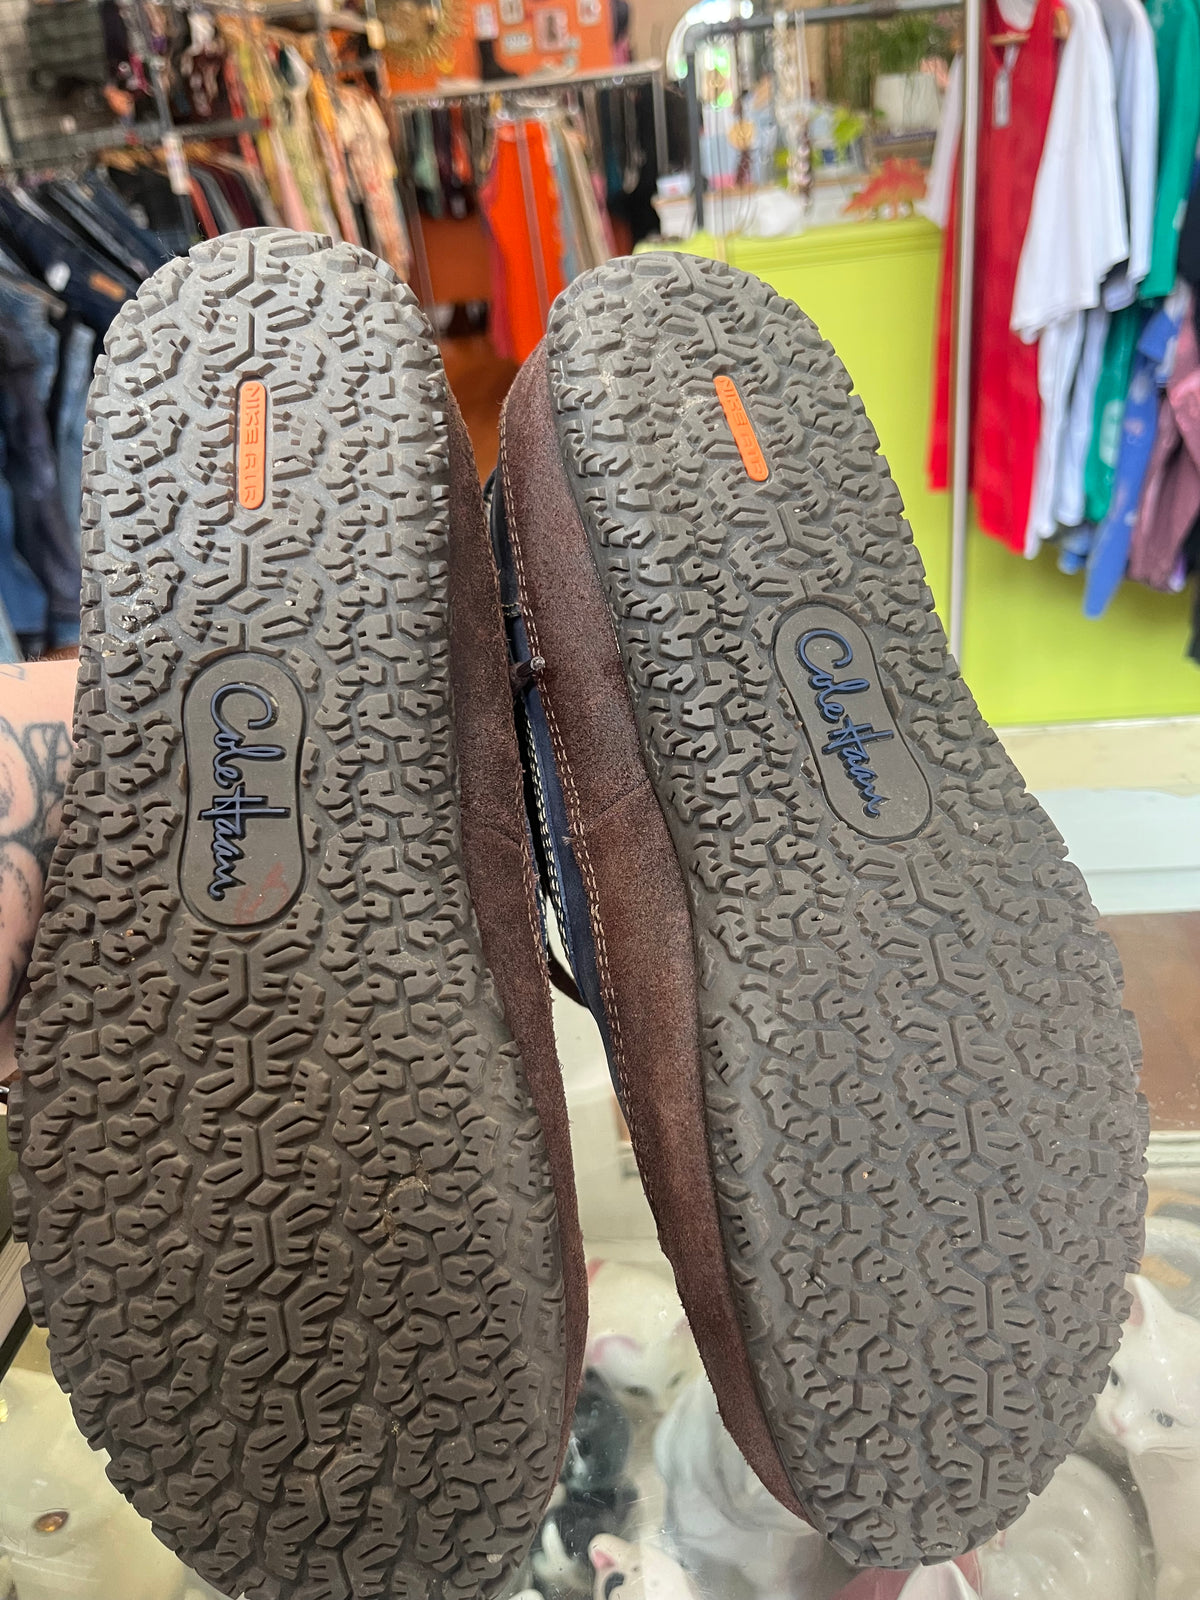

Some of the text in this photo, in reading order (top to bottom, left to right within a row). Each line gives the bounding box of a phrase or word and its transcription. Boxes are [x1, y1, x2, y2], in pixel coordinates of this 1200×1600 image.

[244, 386, 261, 503] NIKE AIR
[718, 379, 749, 427] NIKE
[198, 681, 291, 901] Cole Haan
[796, 628, 894, 819] Cole Haan
